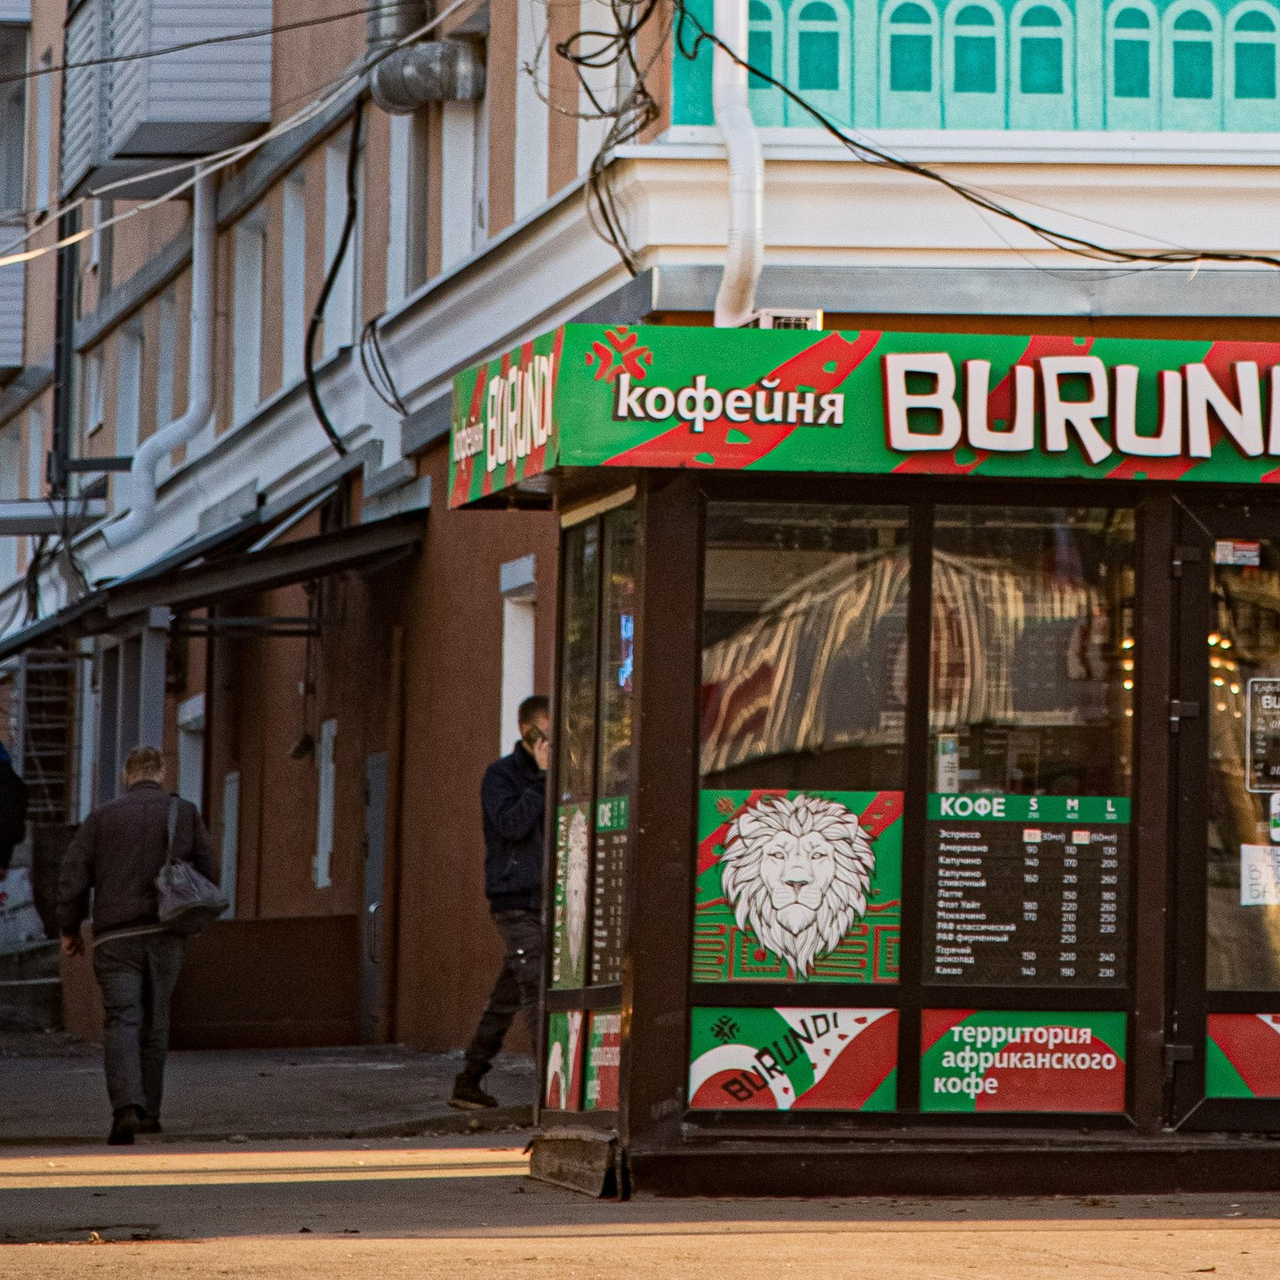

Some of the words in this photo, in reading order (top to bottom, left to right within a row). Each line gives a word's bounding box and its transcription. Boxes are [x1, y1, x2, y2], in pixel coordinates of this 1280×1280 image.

[486, 352, 554, 473] BURUNDI
[616, 372, 845, 433] кофейня
[940, 797, 1006, 817] КОФЕ
[1029, 798, 1039, 811] S
[1066, 799, 1079, 811] M
[1106, 800, 1116, 812] L
[950, 1025, 1093, 1049] территория
[722, 1012, 839, 1102] BURUNDI
[942, 1045, 1117, 1073] африканского
[933, 1070, 999, 1099] кофе
